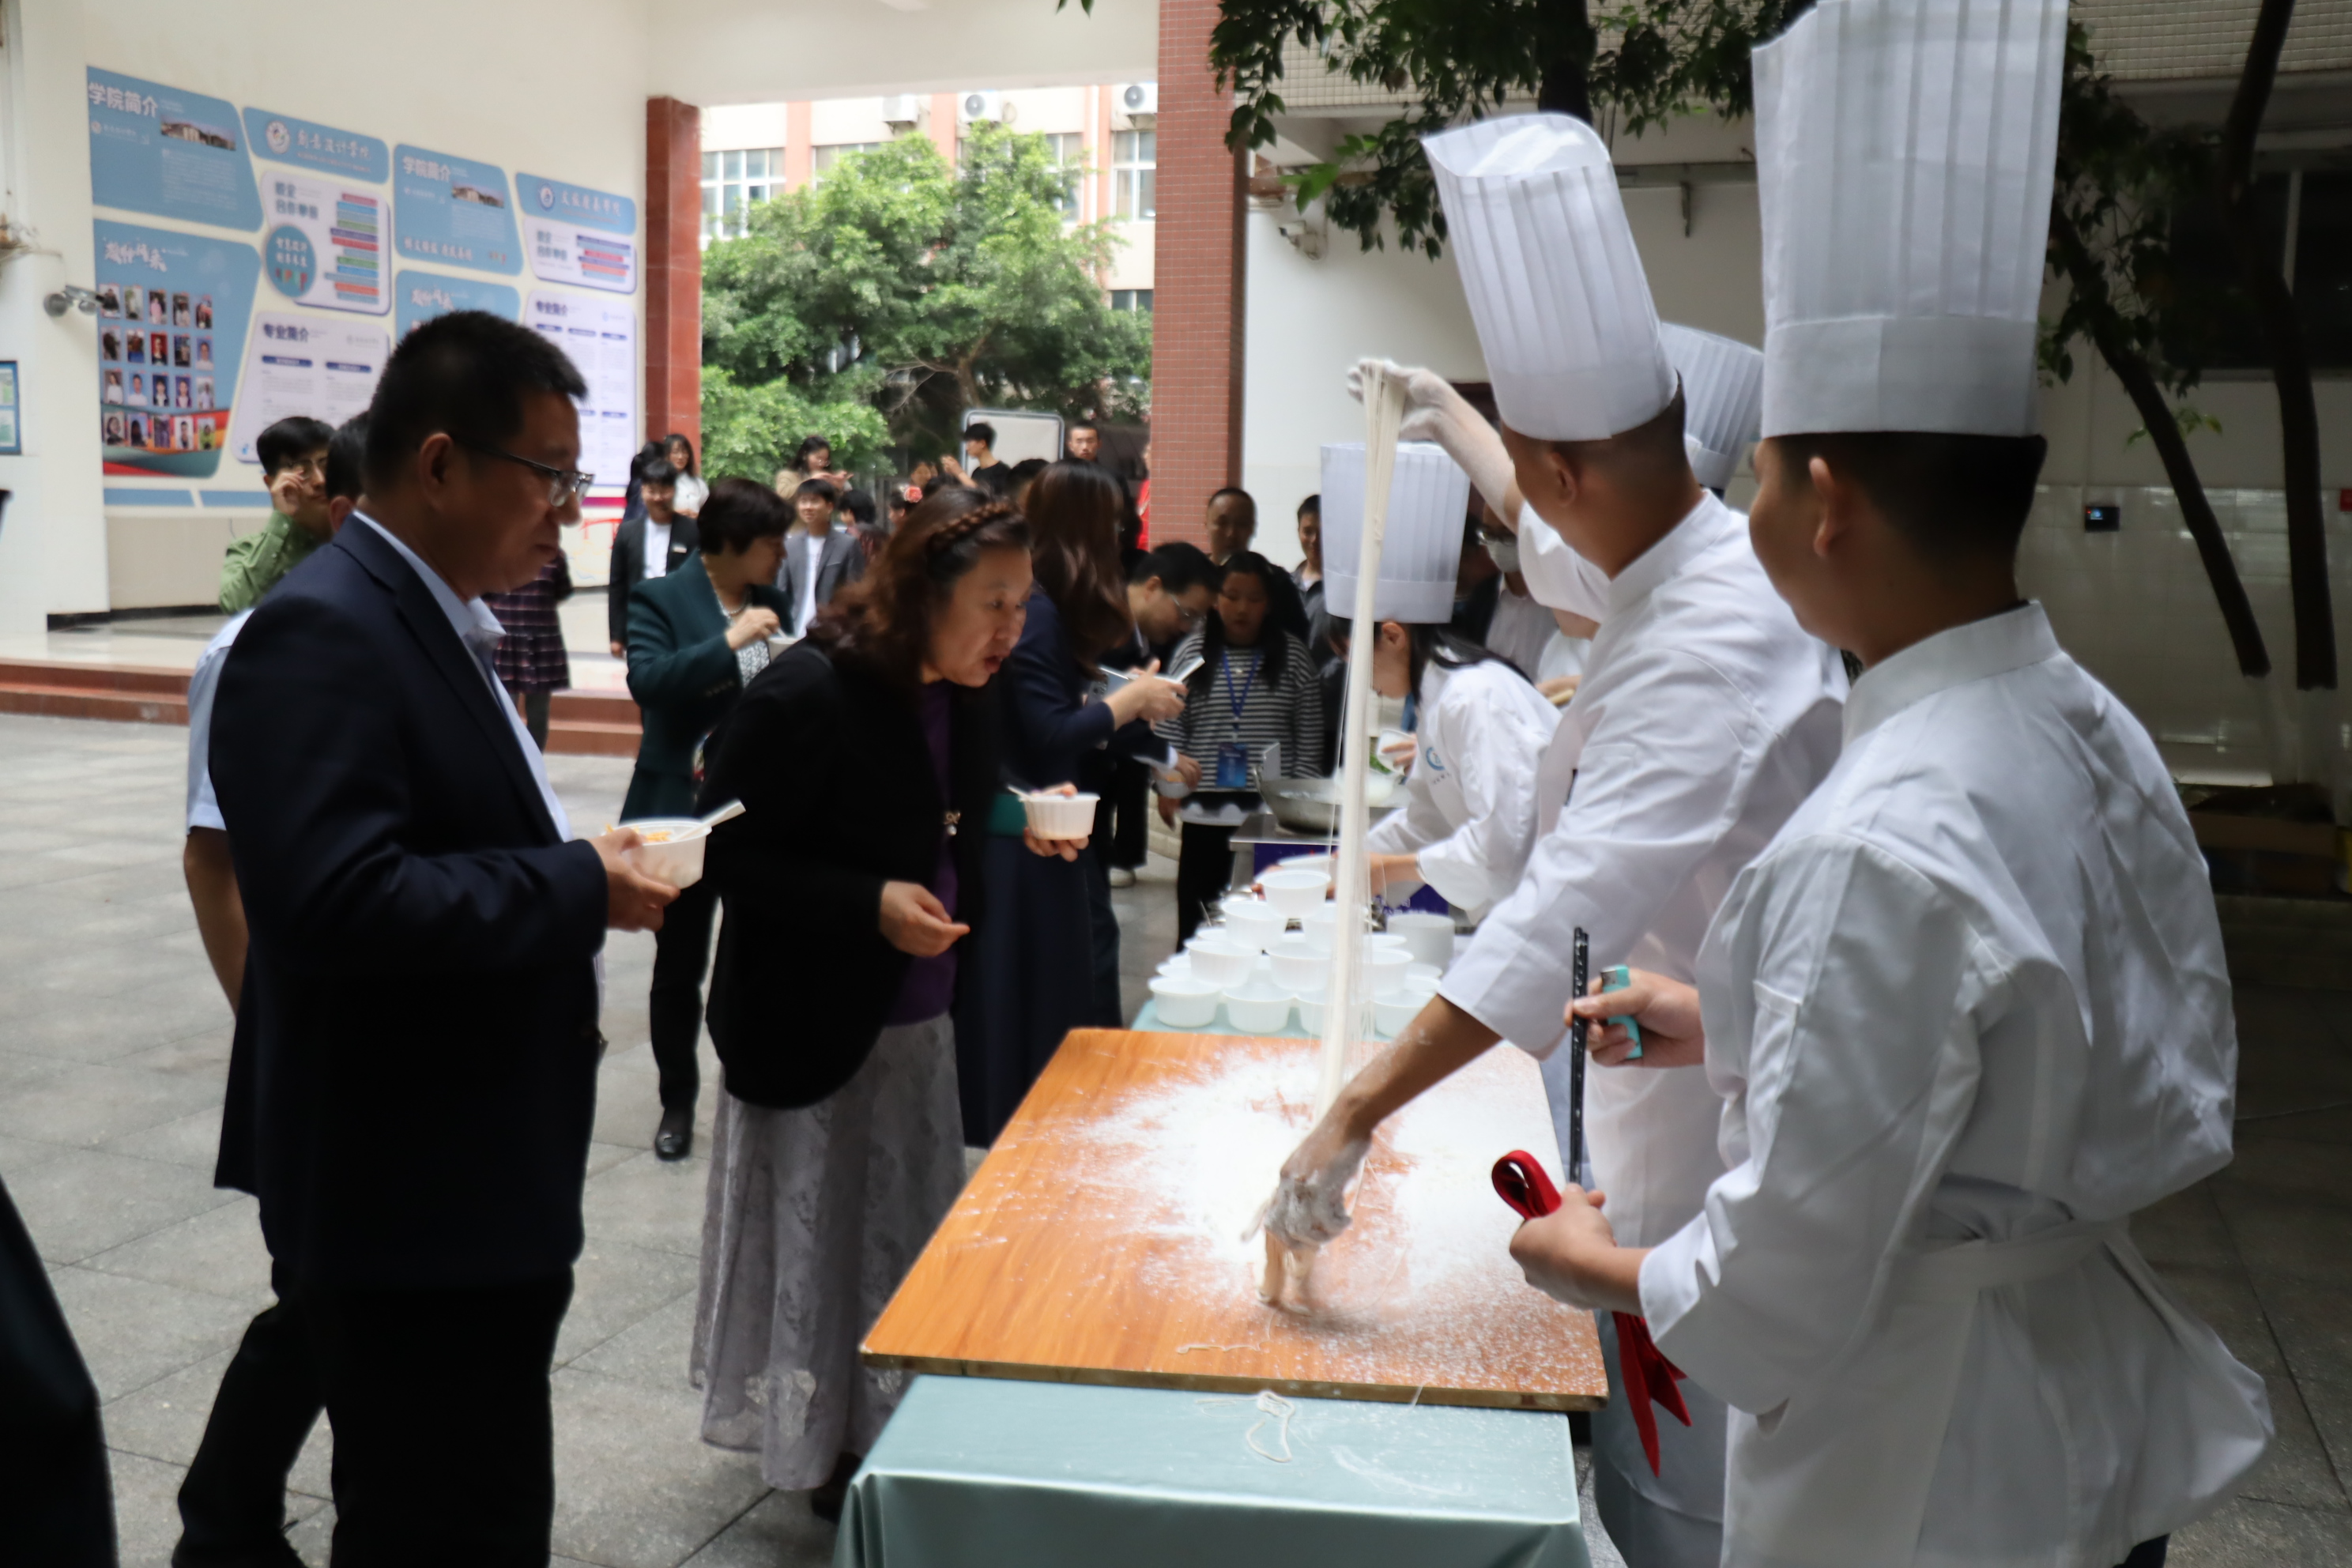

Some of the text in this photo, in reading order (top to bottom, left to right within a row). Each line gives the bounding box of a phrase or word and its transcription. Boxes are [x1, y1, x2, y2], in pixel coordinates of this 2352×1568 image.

[88, 82, 158, 118] 学院简介
[403, 156, 450, 183] 学院简介
[263, 323, 309, 343] 专业简介
